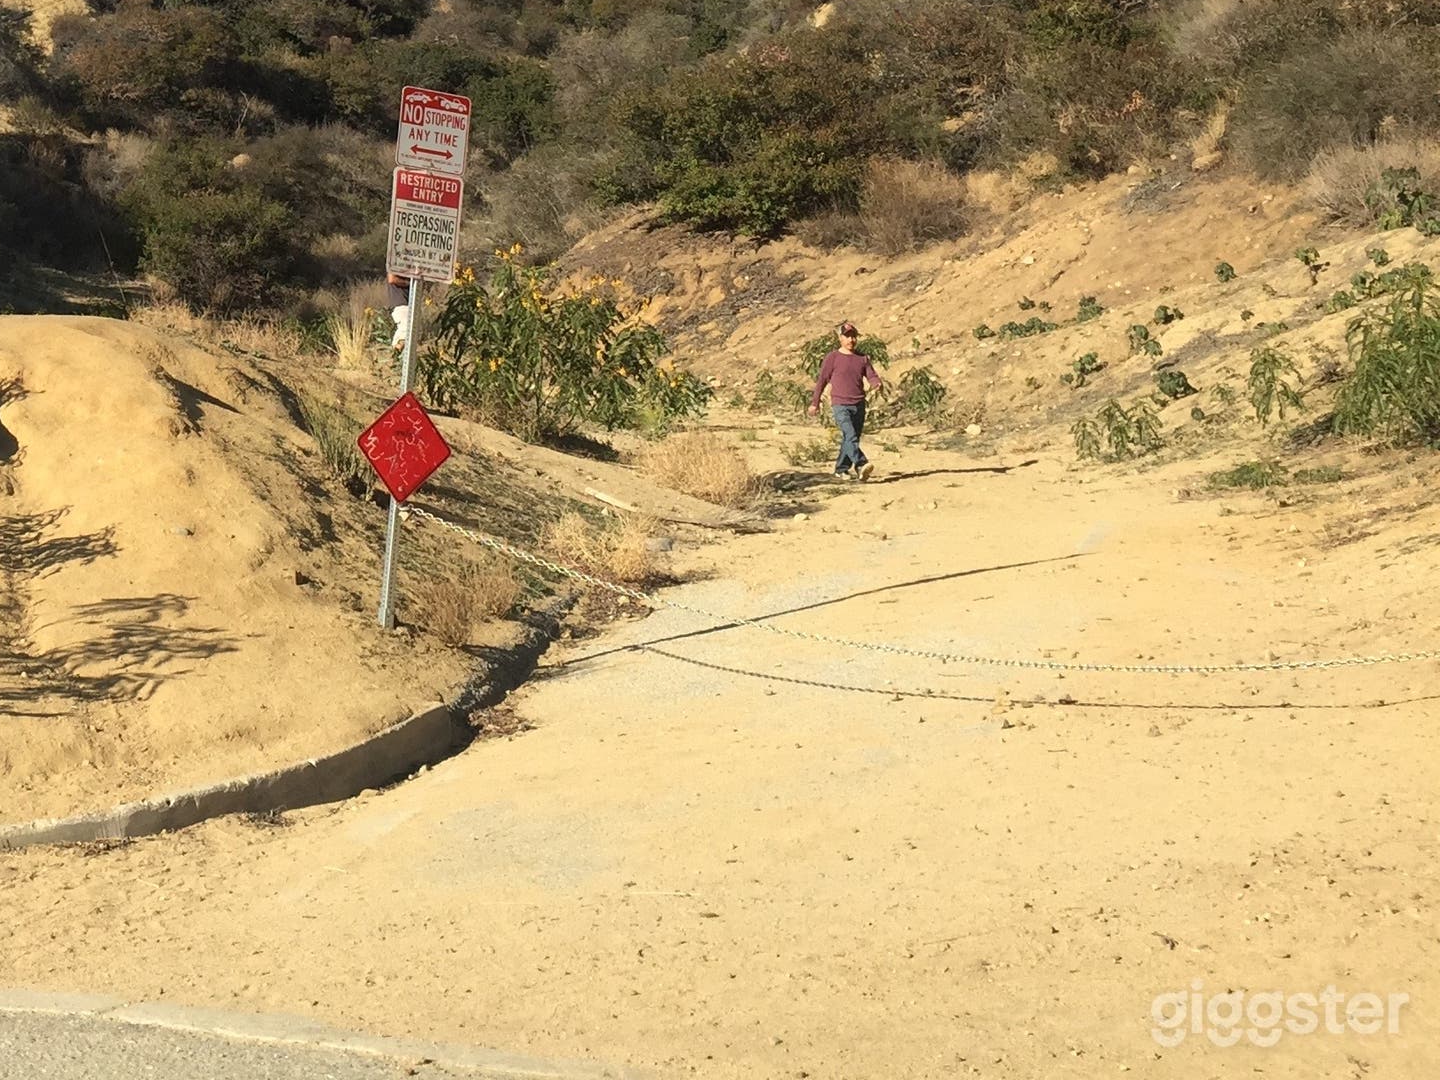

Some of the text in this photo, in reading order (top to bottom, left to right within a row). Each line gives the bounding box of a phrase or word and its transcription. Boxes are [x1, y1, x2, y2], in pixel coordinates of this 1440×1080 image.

[404, 103, 465, 130] NO STOPPING
[409, 128, 458, 147] ANY TIME
[400, 173, 458, 193] RESTRICTED
[412, 187, 445, 204] ENTRY
[396, 210, 455, 235] TRESPASSING
[395, 227, 453, 251] & LOITERING
